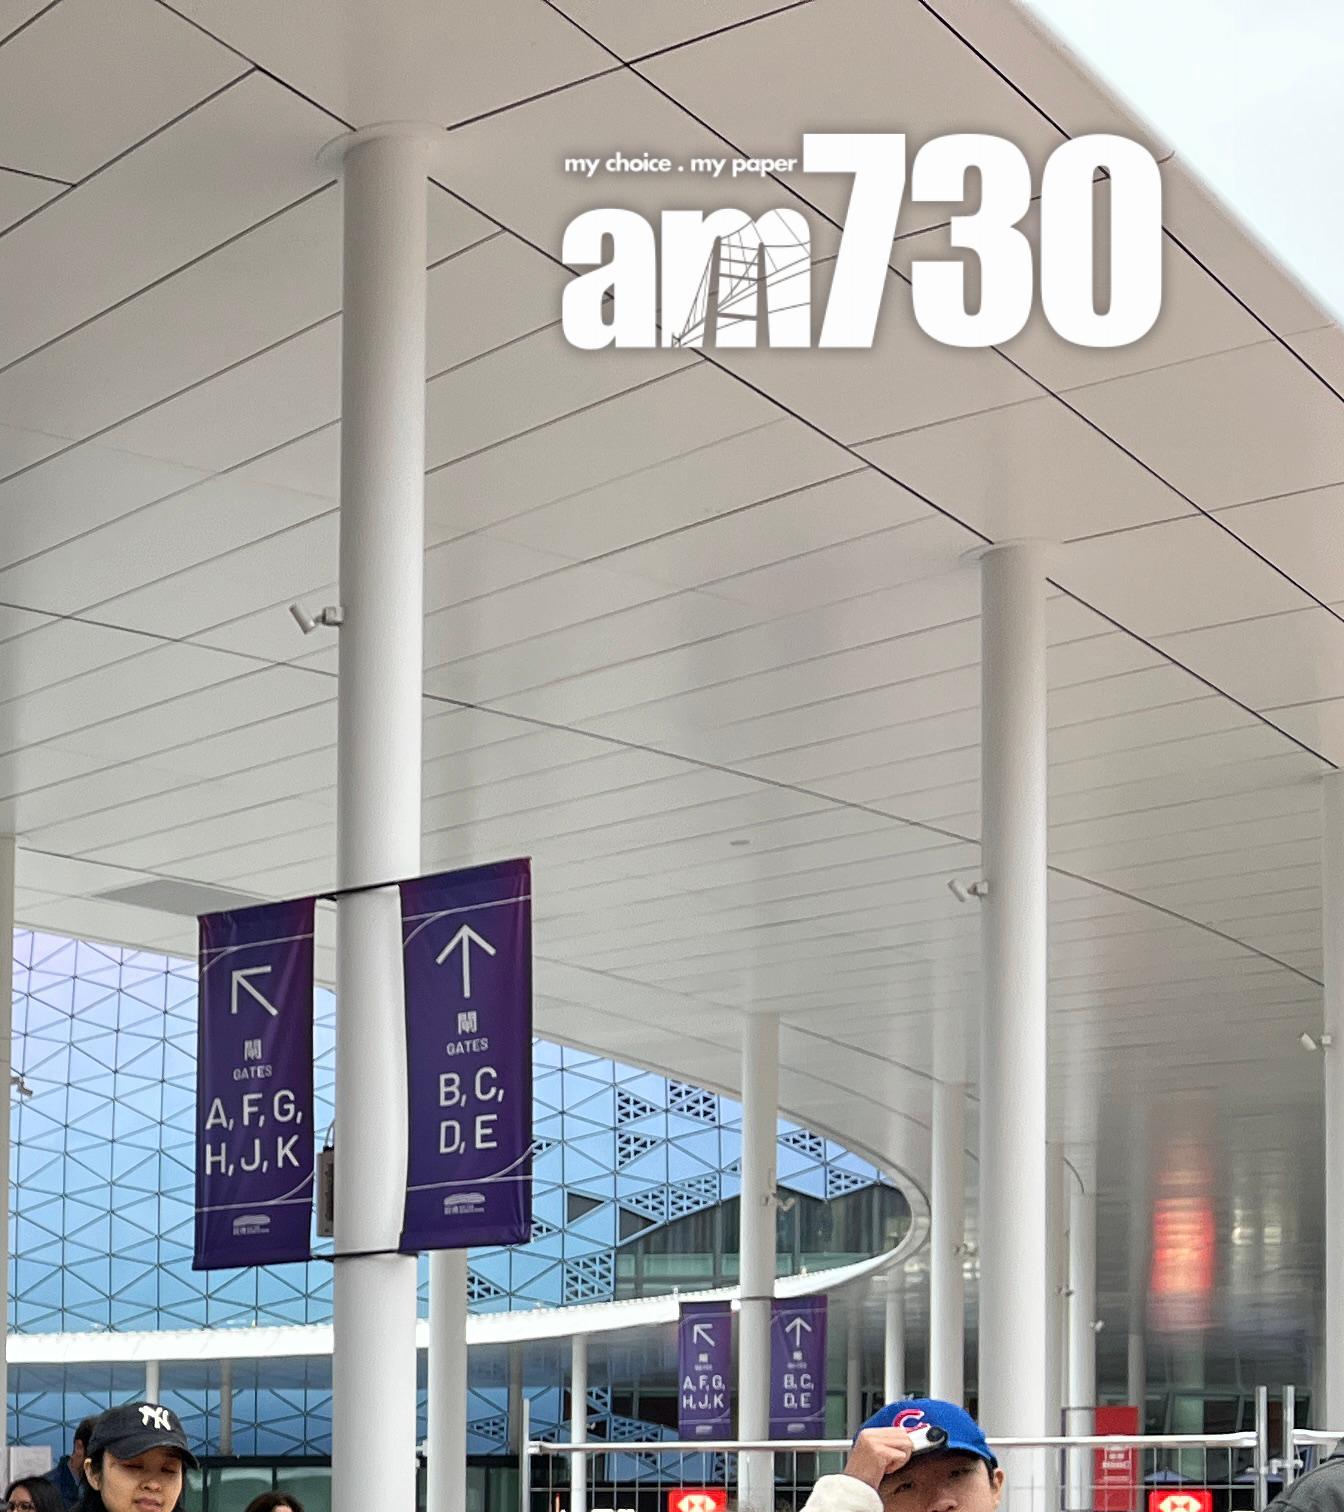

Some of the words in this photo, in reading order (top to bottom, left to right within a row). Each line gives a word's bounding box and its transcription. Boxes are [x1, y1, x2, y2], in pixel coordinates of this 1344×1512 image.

[446, 1037, 488, 1056] GATES
[233, 1064, 272, 1081] GATES
[475, 1114, 497, 1149] E
[277, 1134, 300, 1168] K
